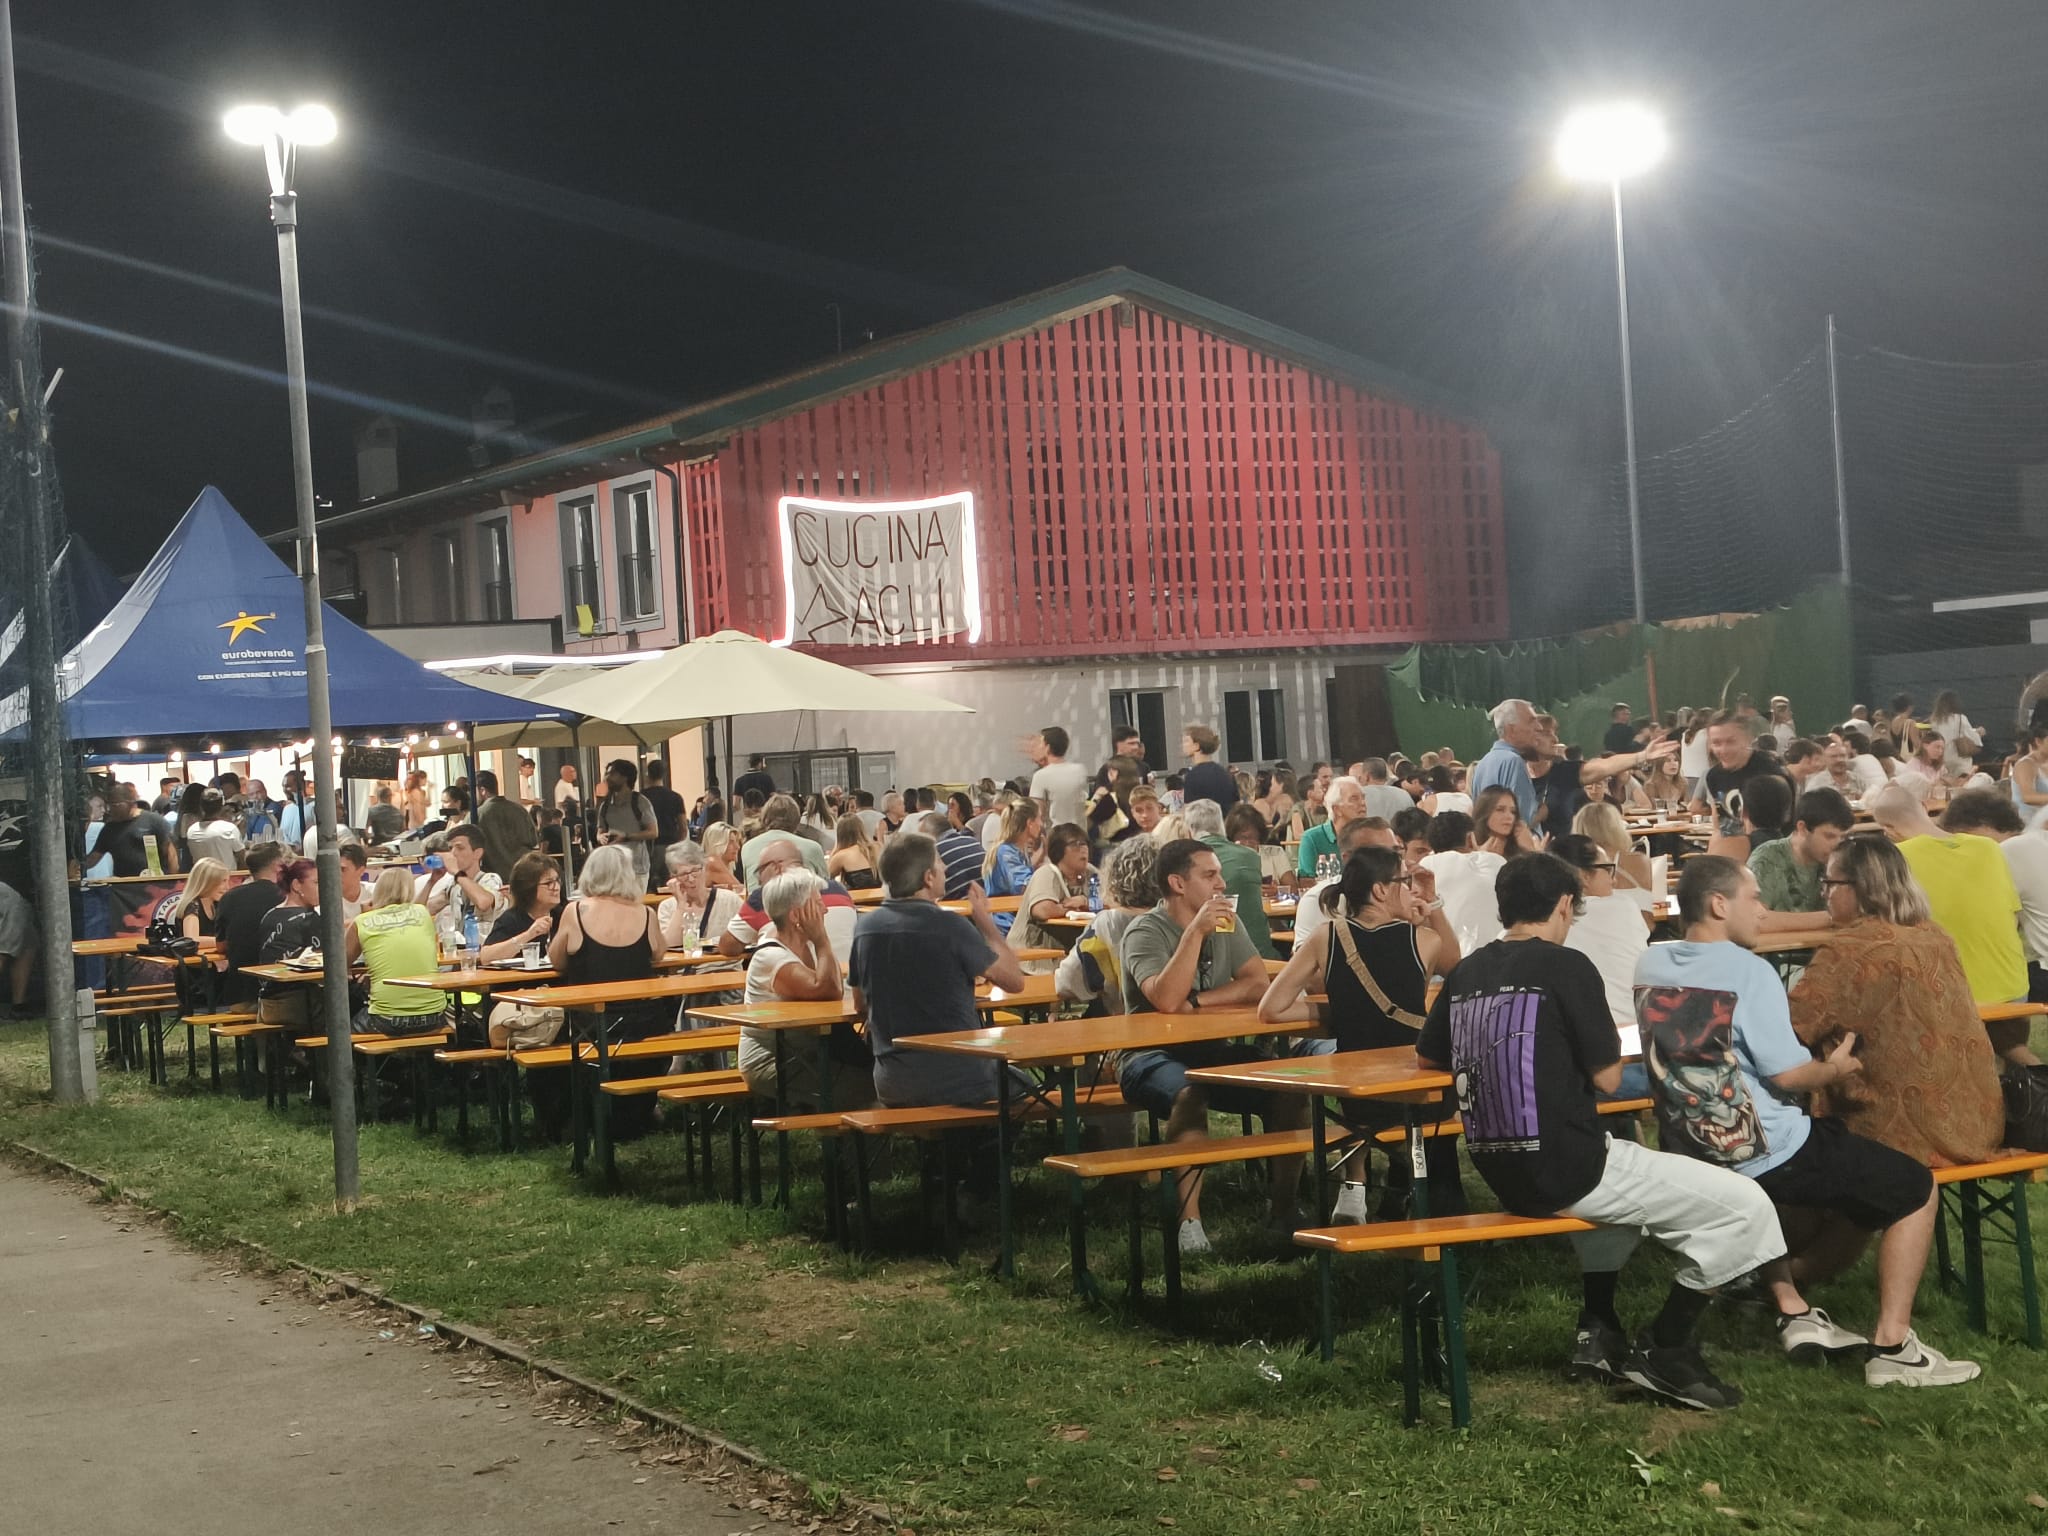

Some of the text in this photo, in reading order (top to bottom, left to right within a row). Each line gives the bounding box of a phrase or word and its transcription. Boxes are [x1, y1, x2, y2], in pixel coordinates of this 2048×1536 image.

[793, 510, 949, 569] CUCINA
[850, 577, 945, 637] ACLI
[221, 649, 295, 660] eurobevande
